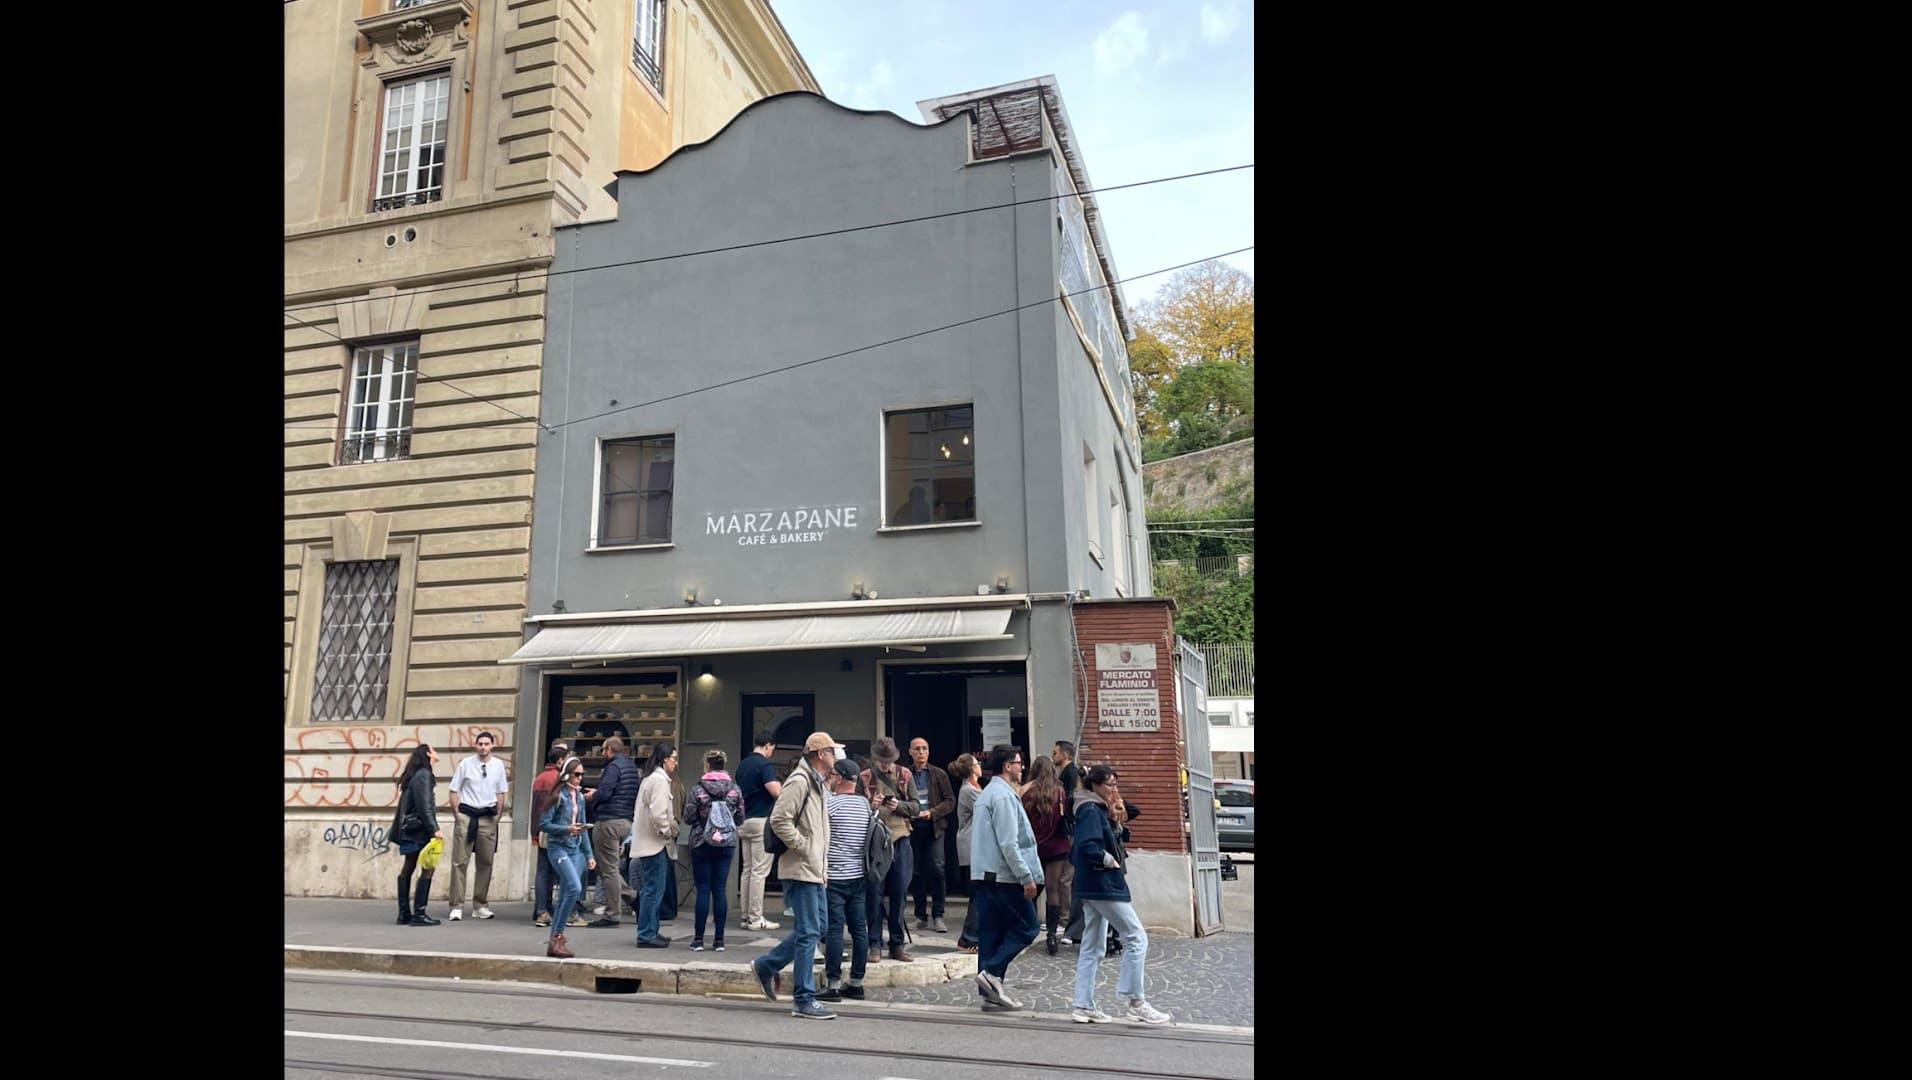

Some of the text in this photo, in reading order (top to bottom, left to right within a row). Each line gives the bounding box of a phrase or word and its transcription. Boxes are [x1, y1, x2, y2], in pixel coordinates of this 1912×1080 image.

[706, 507, 857, 535] MARZAPANE
[738, 531, 824, 546] CAFÉ & BAKERY
[1102, 671, 1152, 680] MERCATO
[1100, 680, 1149, 689] FLAMINIO
[1101, 708, 1157, 717] DALLE 7:00
[1102, 719, 1157, 728] ALLE 15:00
